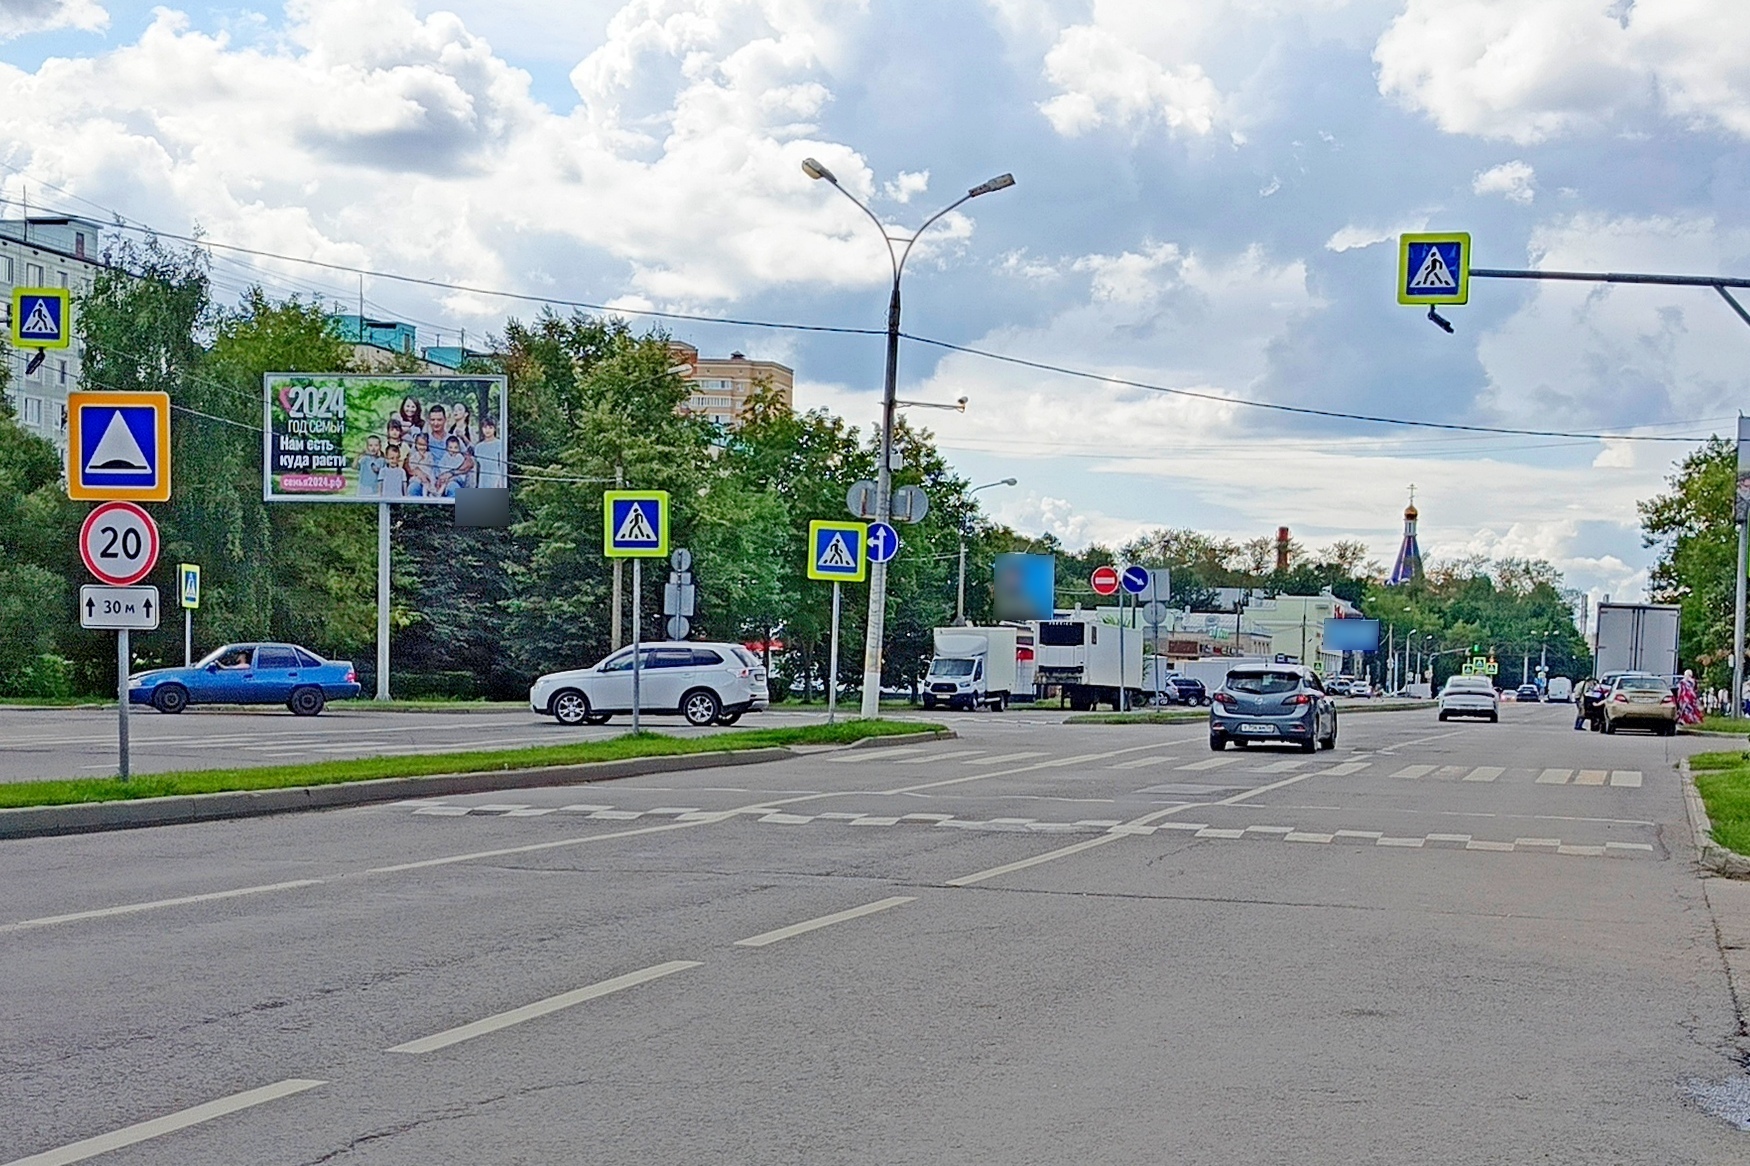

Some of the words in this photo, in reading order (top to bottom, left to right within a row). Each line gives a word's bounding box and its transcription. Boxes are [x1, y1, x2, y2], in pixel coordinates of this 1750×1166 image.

[289, 386, 346, 418] 2024
[280, 435, 304, 451] Нам
[306, 439, 334, 451] есть
[280, 454, 309, 469] куда
[312, 454, 347, 469] расти
[100, 526, 142, 560] 20
[103, 600, 122, 614] 30
